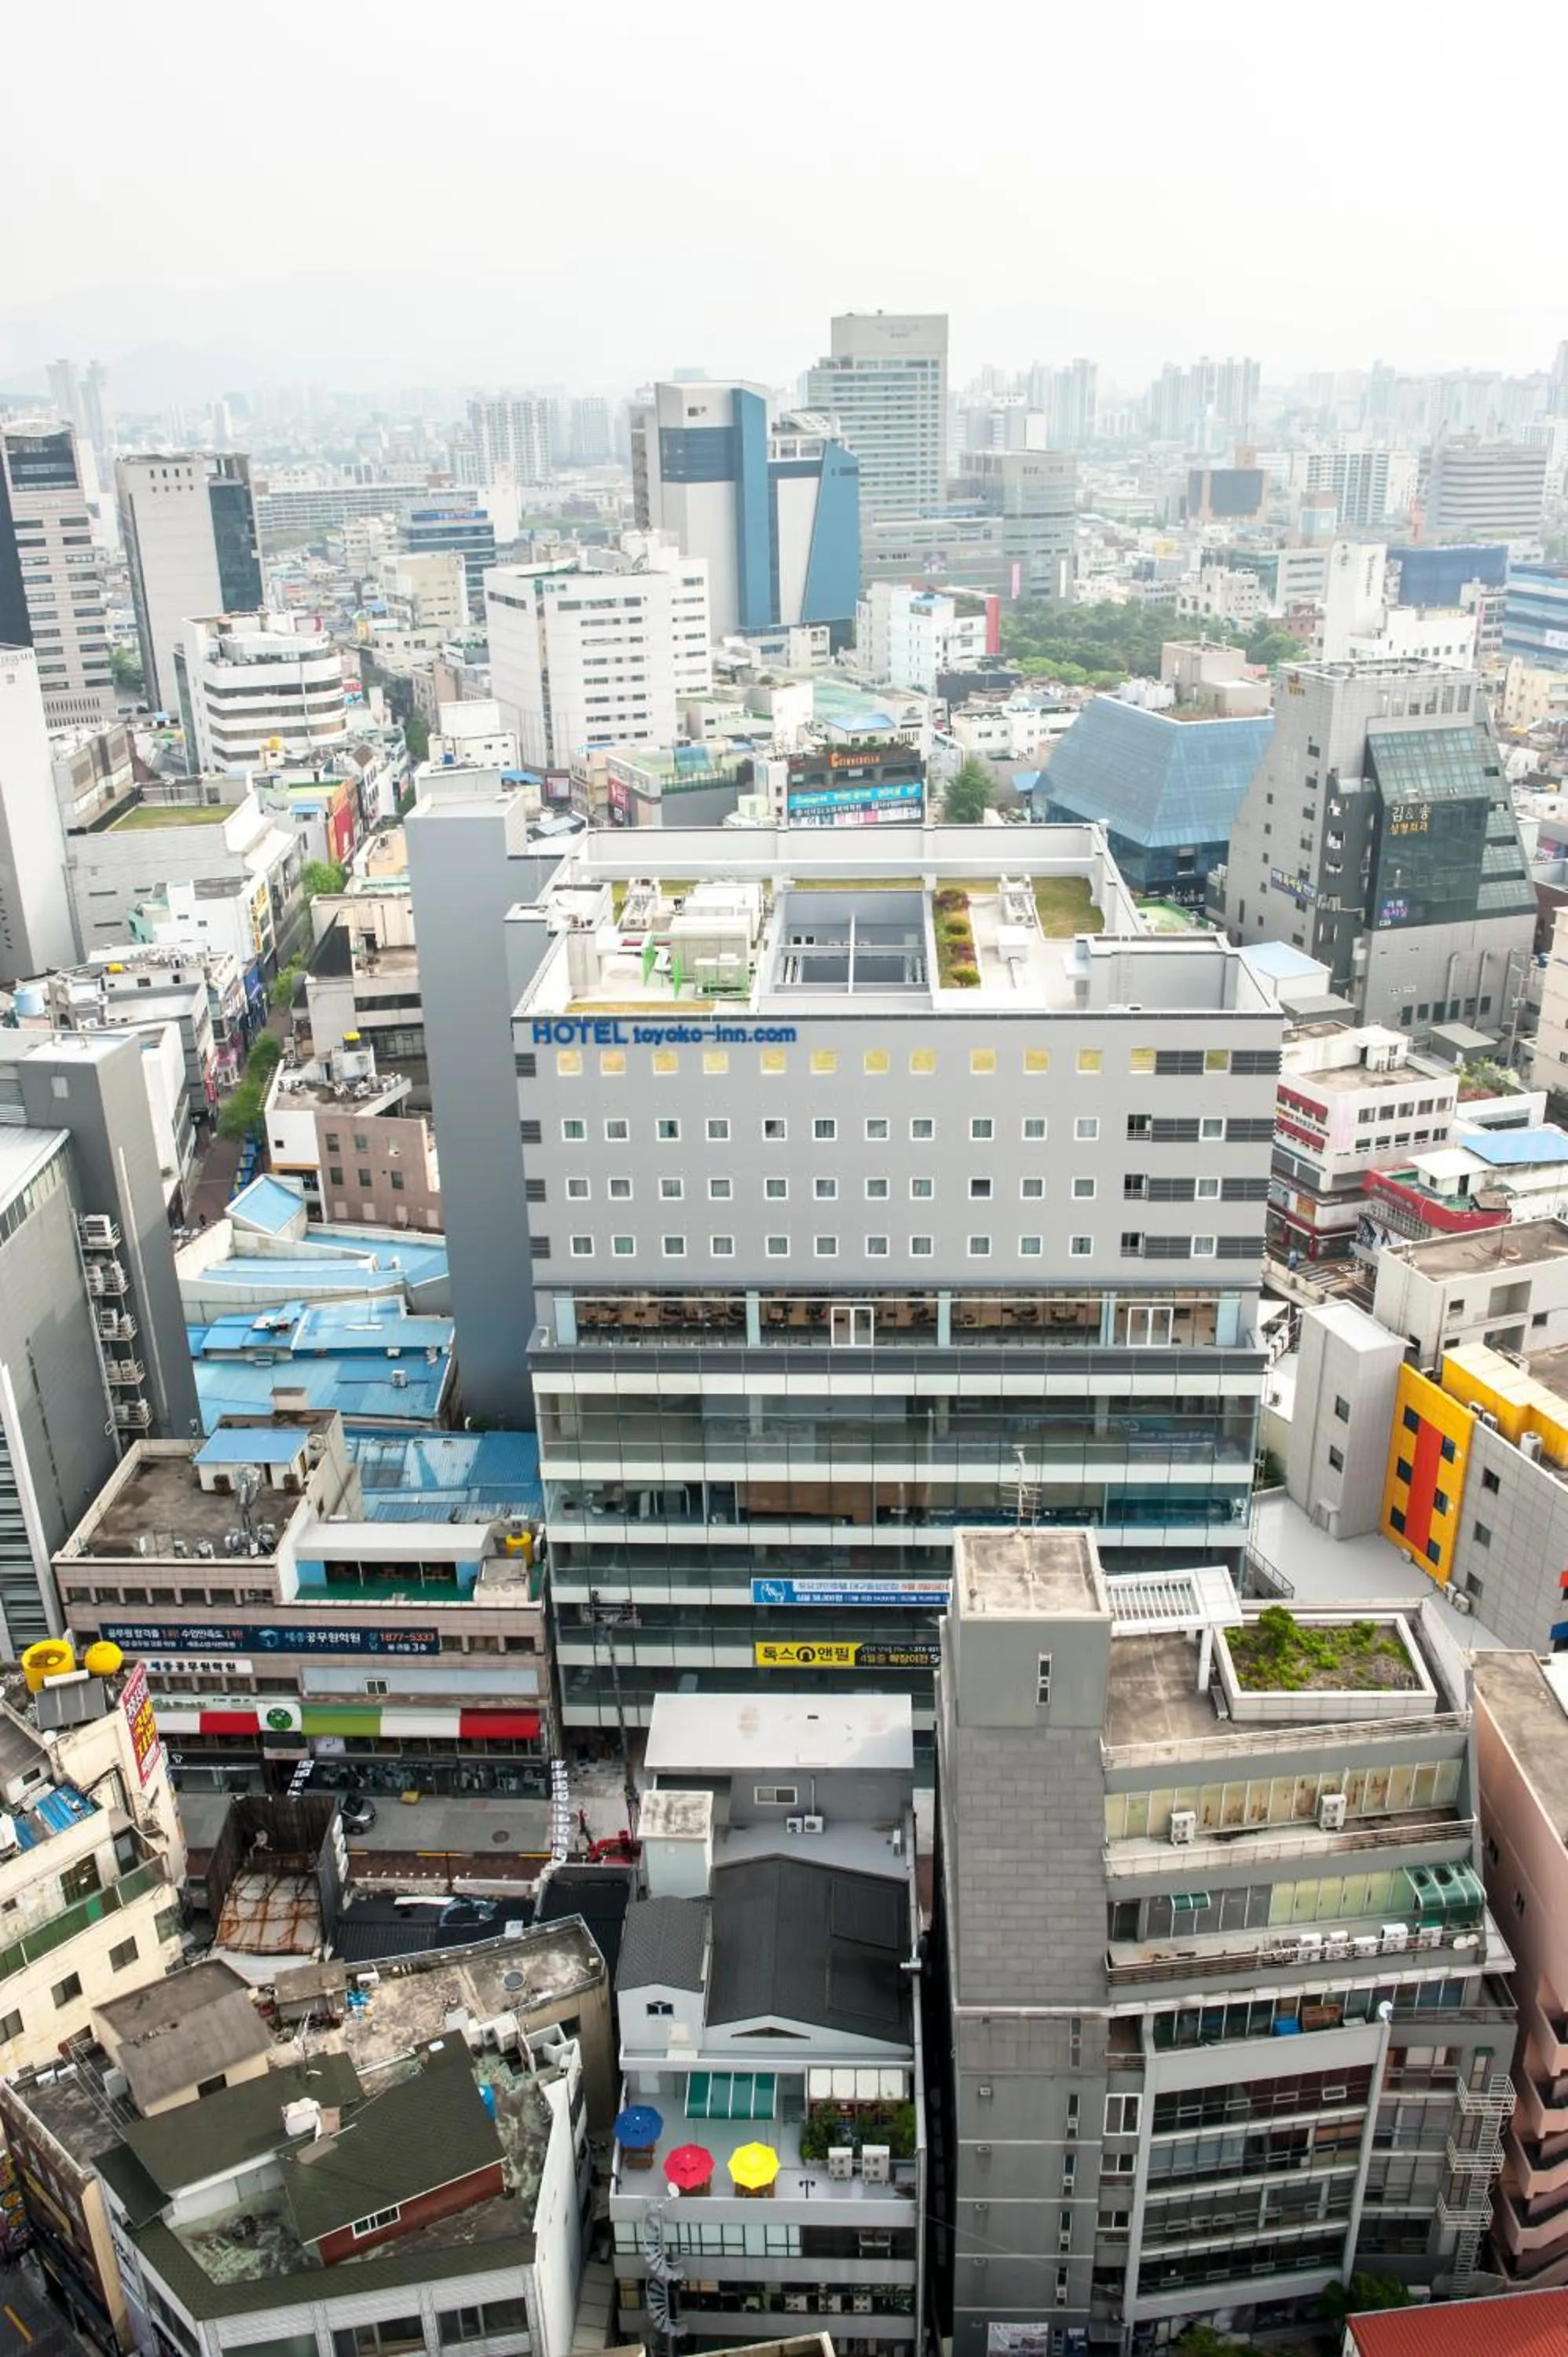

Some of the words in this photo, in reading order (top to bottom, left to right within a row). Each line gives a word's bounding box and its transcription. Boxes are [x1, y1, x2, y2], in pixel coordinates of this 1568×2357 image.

[532, 1022, 628, 1044] HOTEL
[632, 1025, 797, 1046] toyoko-inn.com
[151, 1661, 236, 1673] 세종공무원학원
